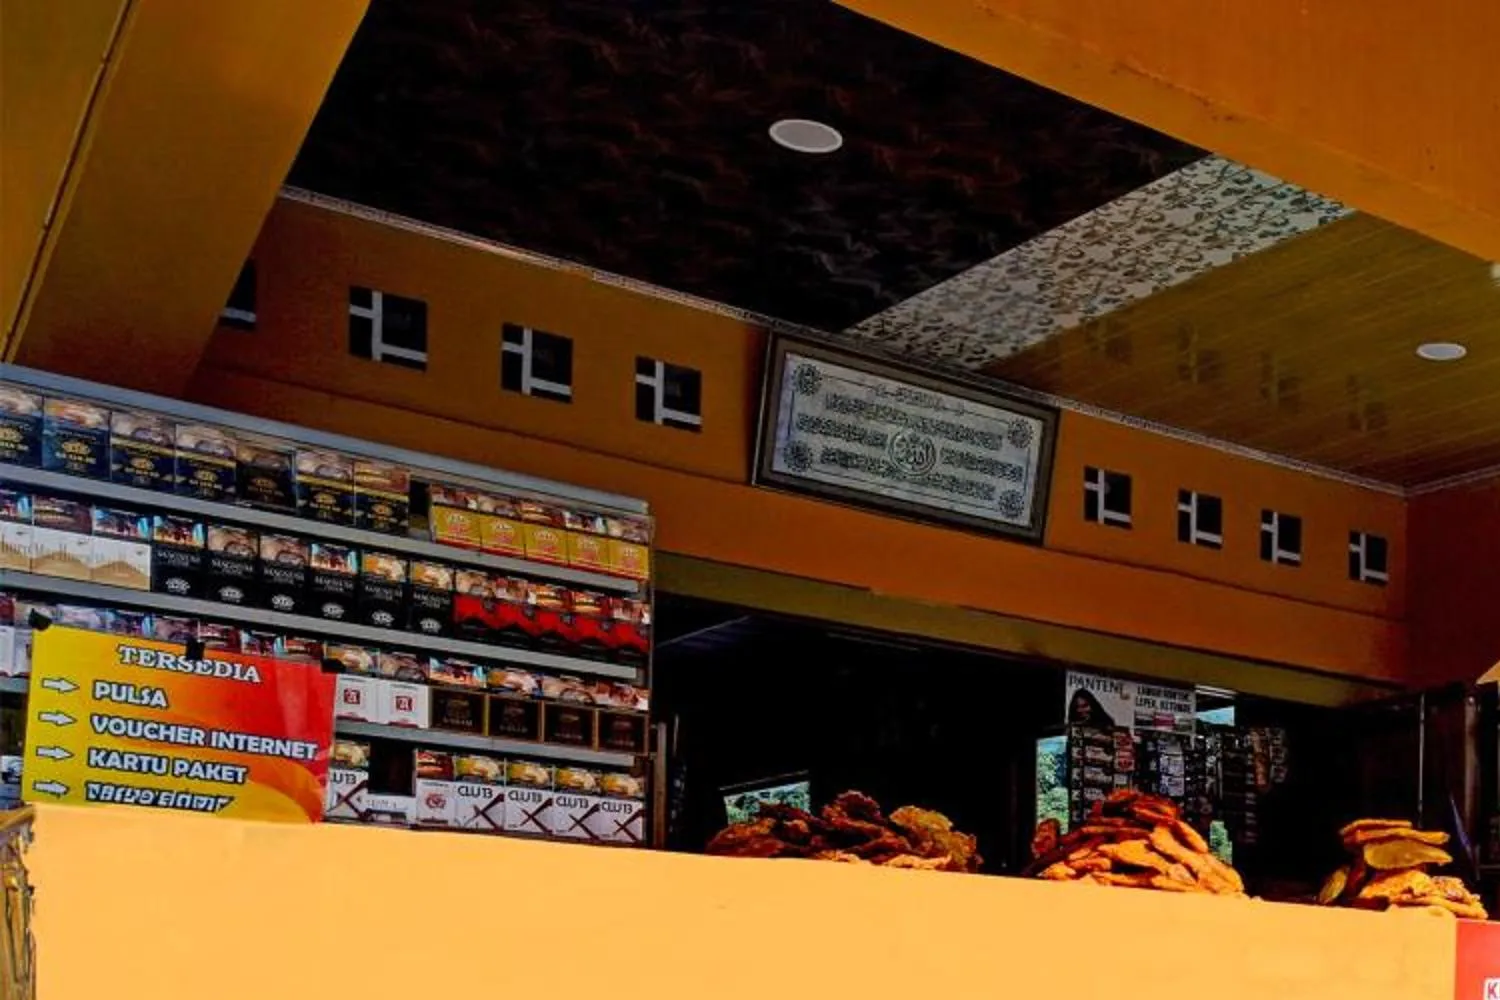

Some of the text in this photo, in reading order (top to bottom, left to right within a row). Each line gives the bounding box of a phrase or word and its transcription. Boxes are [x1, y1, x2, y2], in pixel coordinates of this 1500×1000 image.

[118, 644, 262, 683] TERSEDIA
[93, 680, 168, 709] PULSA
[90, 713, 319, 761] VOUCHER INTERNET
[88, 747, 248, 785] KARTU PAKET
